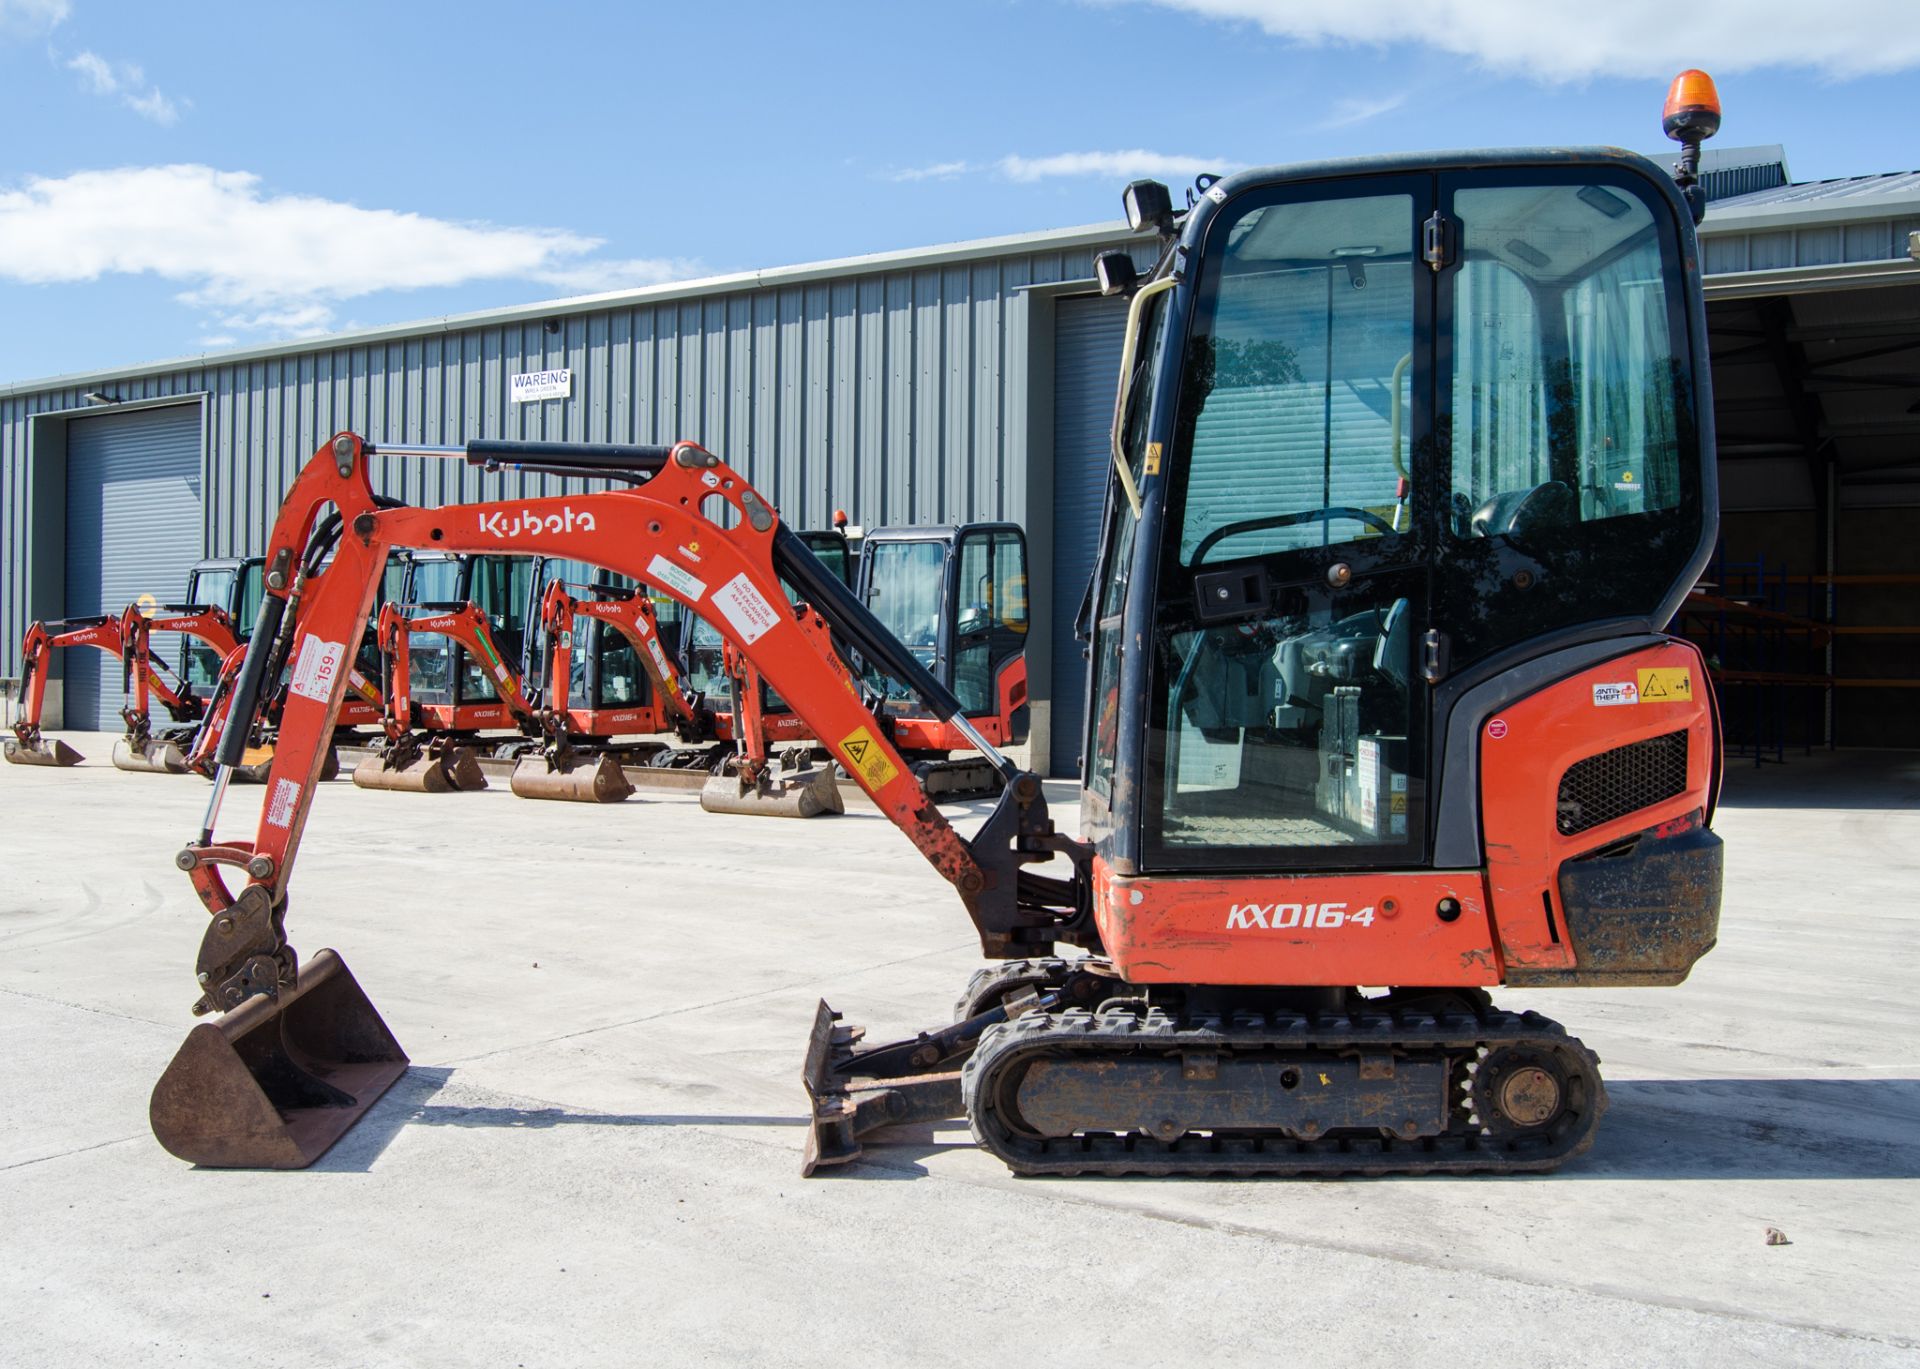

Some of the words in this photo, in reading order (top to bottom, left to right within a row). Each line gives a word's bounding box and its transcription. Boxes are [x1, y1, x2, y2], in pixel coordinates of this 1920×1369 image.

[514, 371, 568, 388] WAREING
[478, 506, 596, 538] Kubota
[596, 604, 622, 614] Kubota
[730, 593, 739, 602] AS
[741, 606, 759, 626] CRANE
[731, 581, 743, 595] THIS
[742, 595, 770, 627] EXCAVATOR
[742, 583, 751, 593] DO
[750, 592, 761, 605] NOT
[760, 605, 771, 617] USE
[172, 620, 198, 629] Kubota
[430, 619, 457, 628] Kubota
[73, 632, 98, 642] Kubota
[316, 656, 334, 680] 159
[1225, 902, 1375, 929] KX016-4
